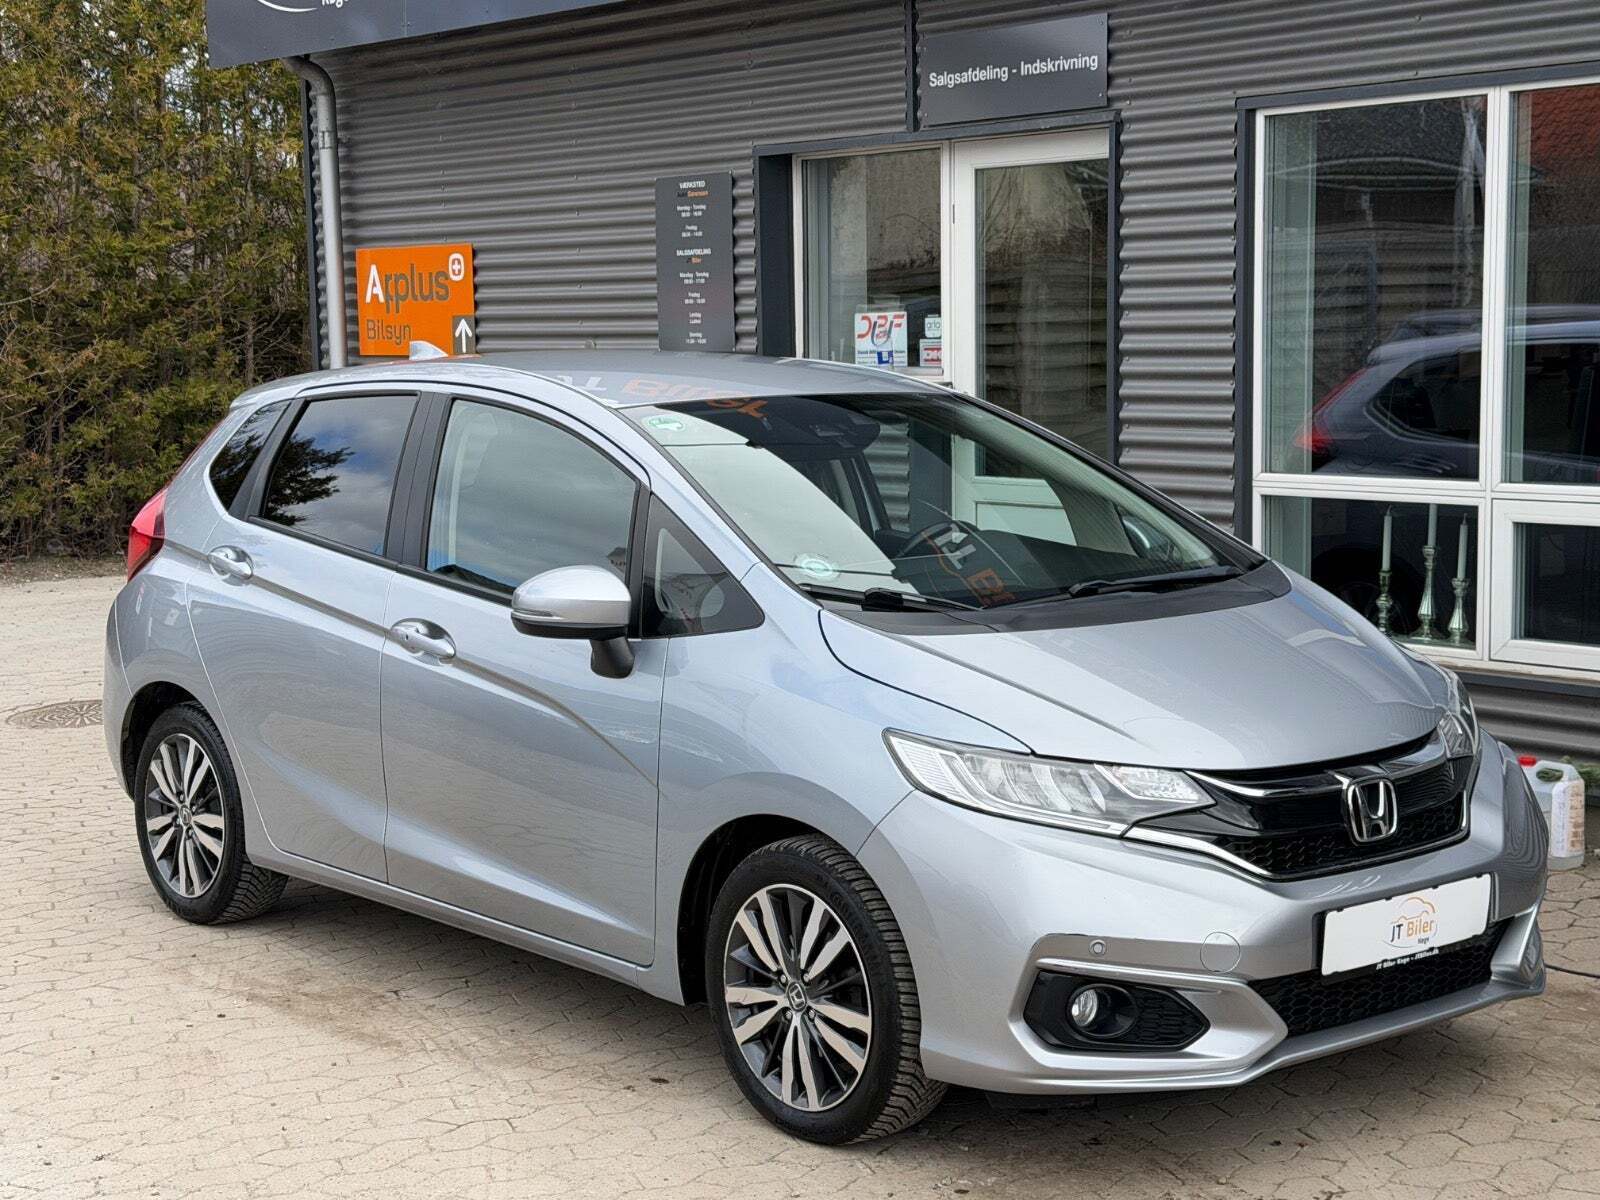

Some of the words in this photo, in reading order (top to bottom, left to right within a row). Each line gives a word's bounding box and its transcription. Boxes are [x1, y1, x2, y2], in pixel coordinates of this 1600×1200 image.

[929, 65, 1009, 88] Salgsafdeling
[1020, 53, 1098, 76] Indskrivning
[367, 319, 411, 346] Bilsyn
[1390, 923, 1404, 943] JT
[1407, 918, 1434, 937] Biler
